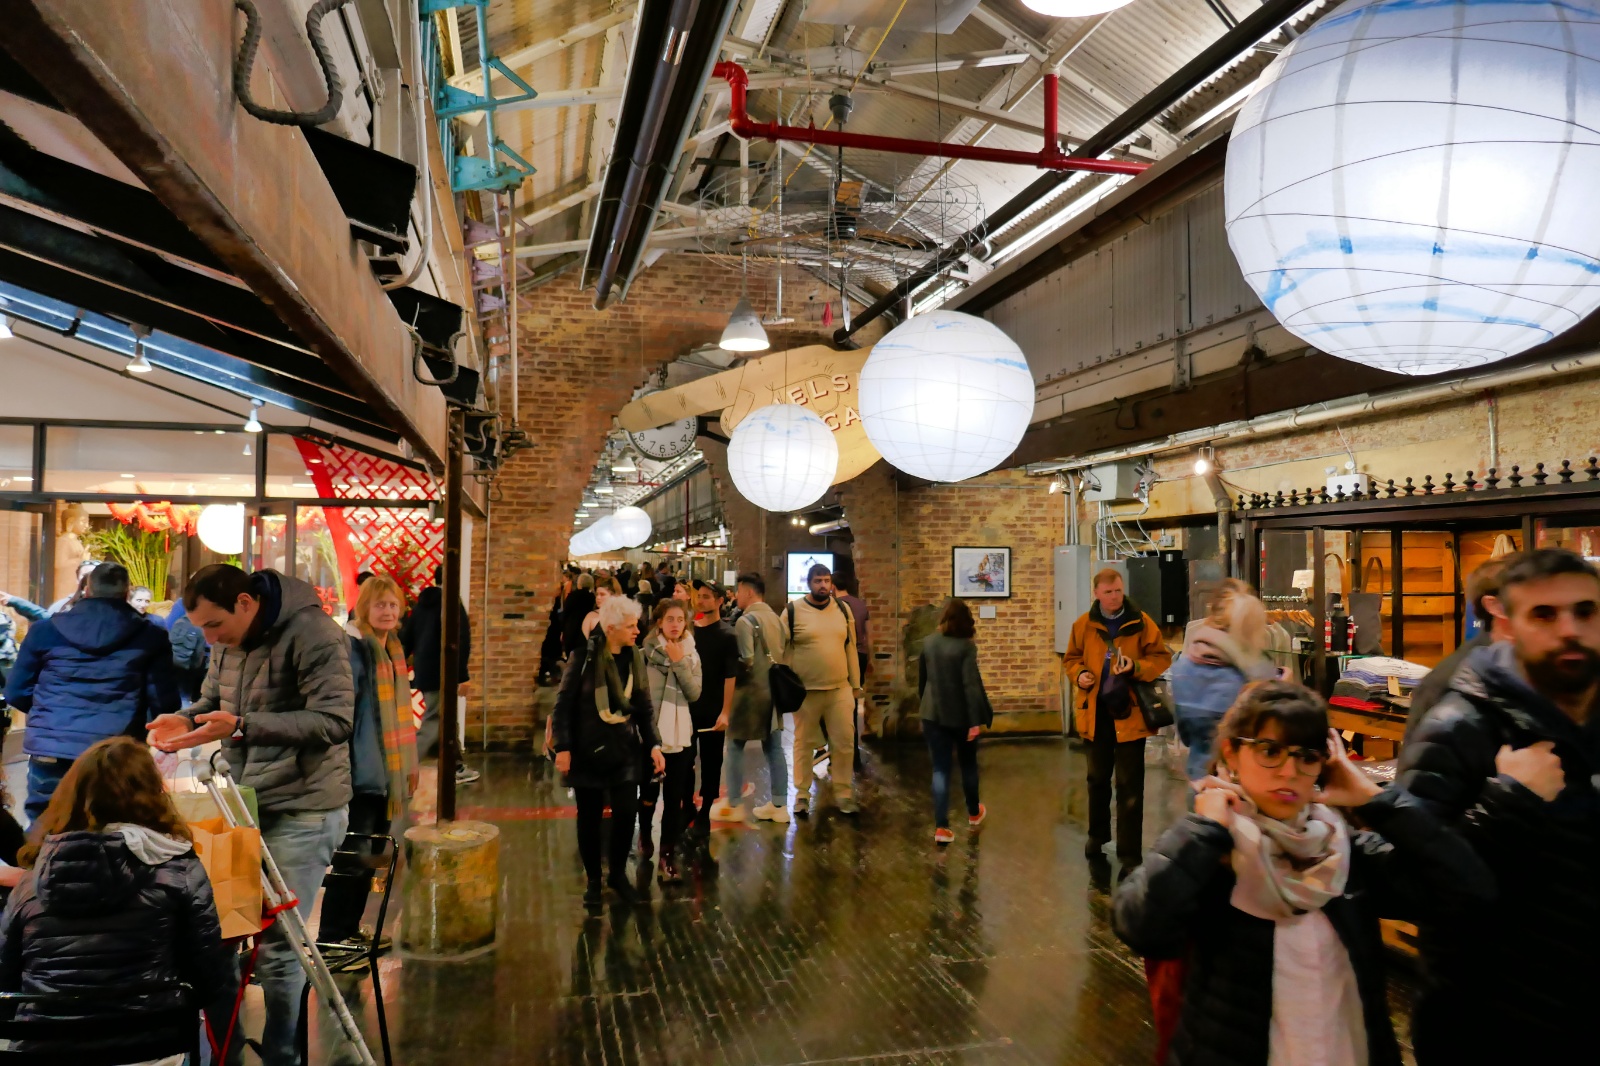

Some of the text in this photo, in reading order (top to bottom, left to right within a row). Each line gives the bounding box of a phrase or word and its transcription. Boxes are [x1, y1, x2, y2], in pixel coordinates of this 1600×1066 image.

[774, 373, 860, 406] ELS
[685, 420, 691, 430] 3
[638, 432, 645, 441] 8
[680, 434, 687, 442] 4
[649, 441, 656, 450] 7
[659, 444, 666, 454] 6
[670, 442, 677, 451] 5
